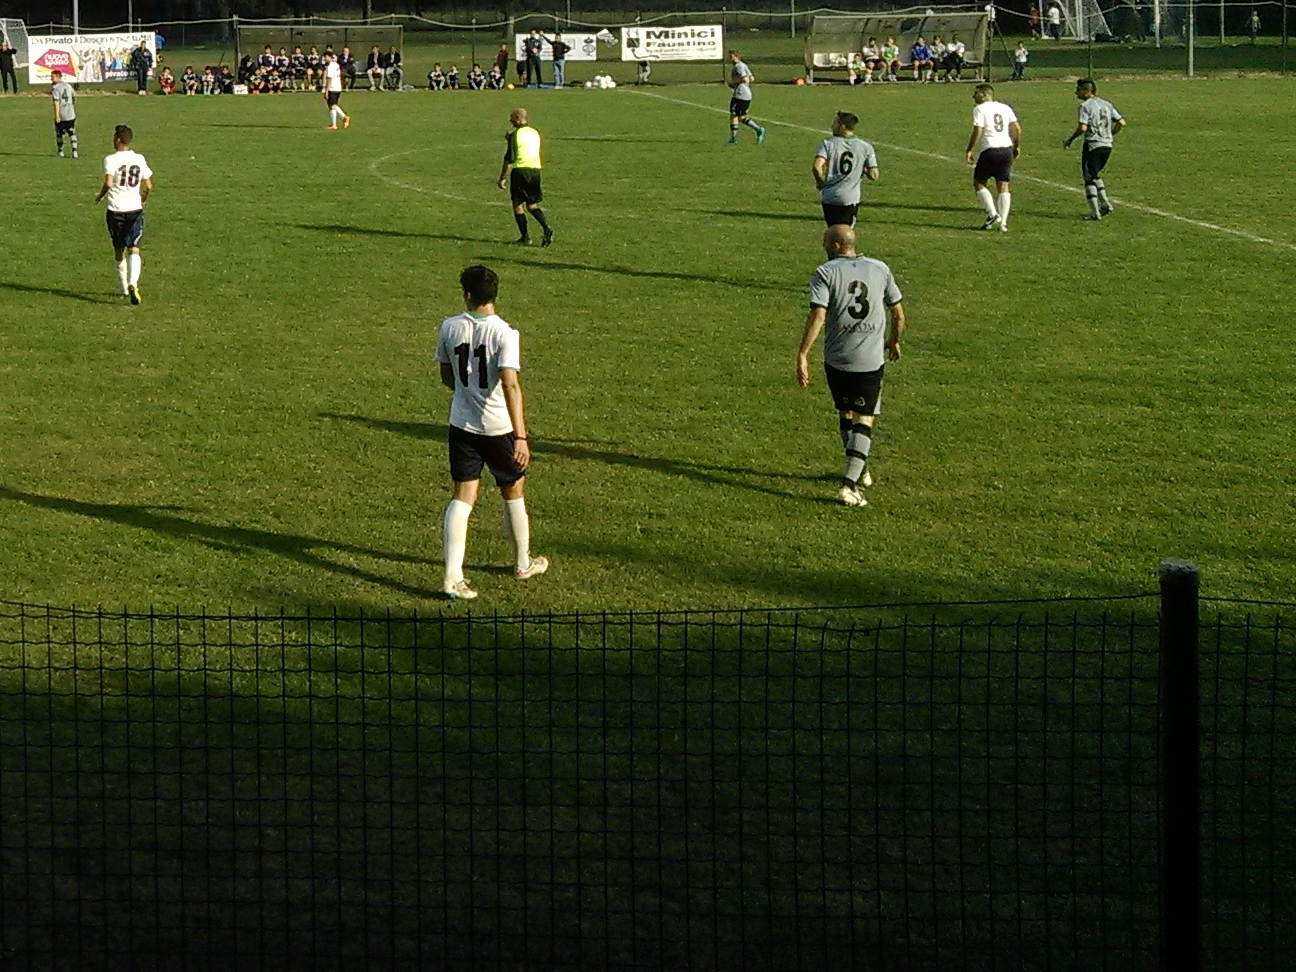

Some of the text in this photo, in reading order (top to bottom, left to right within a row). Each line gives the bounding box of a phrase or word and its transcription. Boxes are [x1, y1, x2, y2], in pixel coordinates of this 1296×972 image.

[45, 37, 73, 45] Pivato
[80, 36, 108, 45] Design
[646, 28, 715, 39] Minici
[104, 70, 129, 79] pivato
[62, 88, 69, 103] 4
[840, 151, 853, 176] 6
[118, 164, 141, 187] 18
[847, 280, 870, 320] 3
[453, 342, 488, 389] 11
